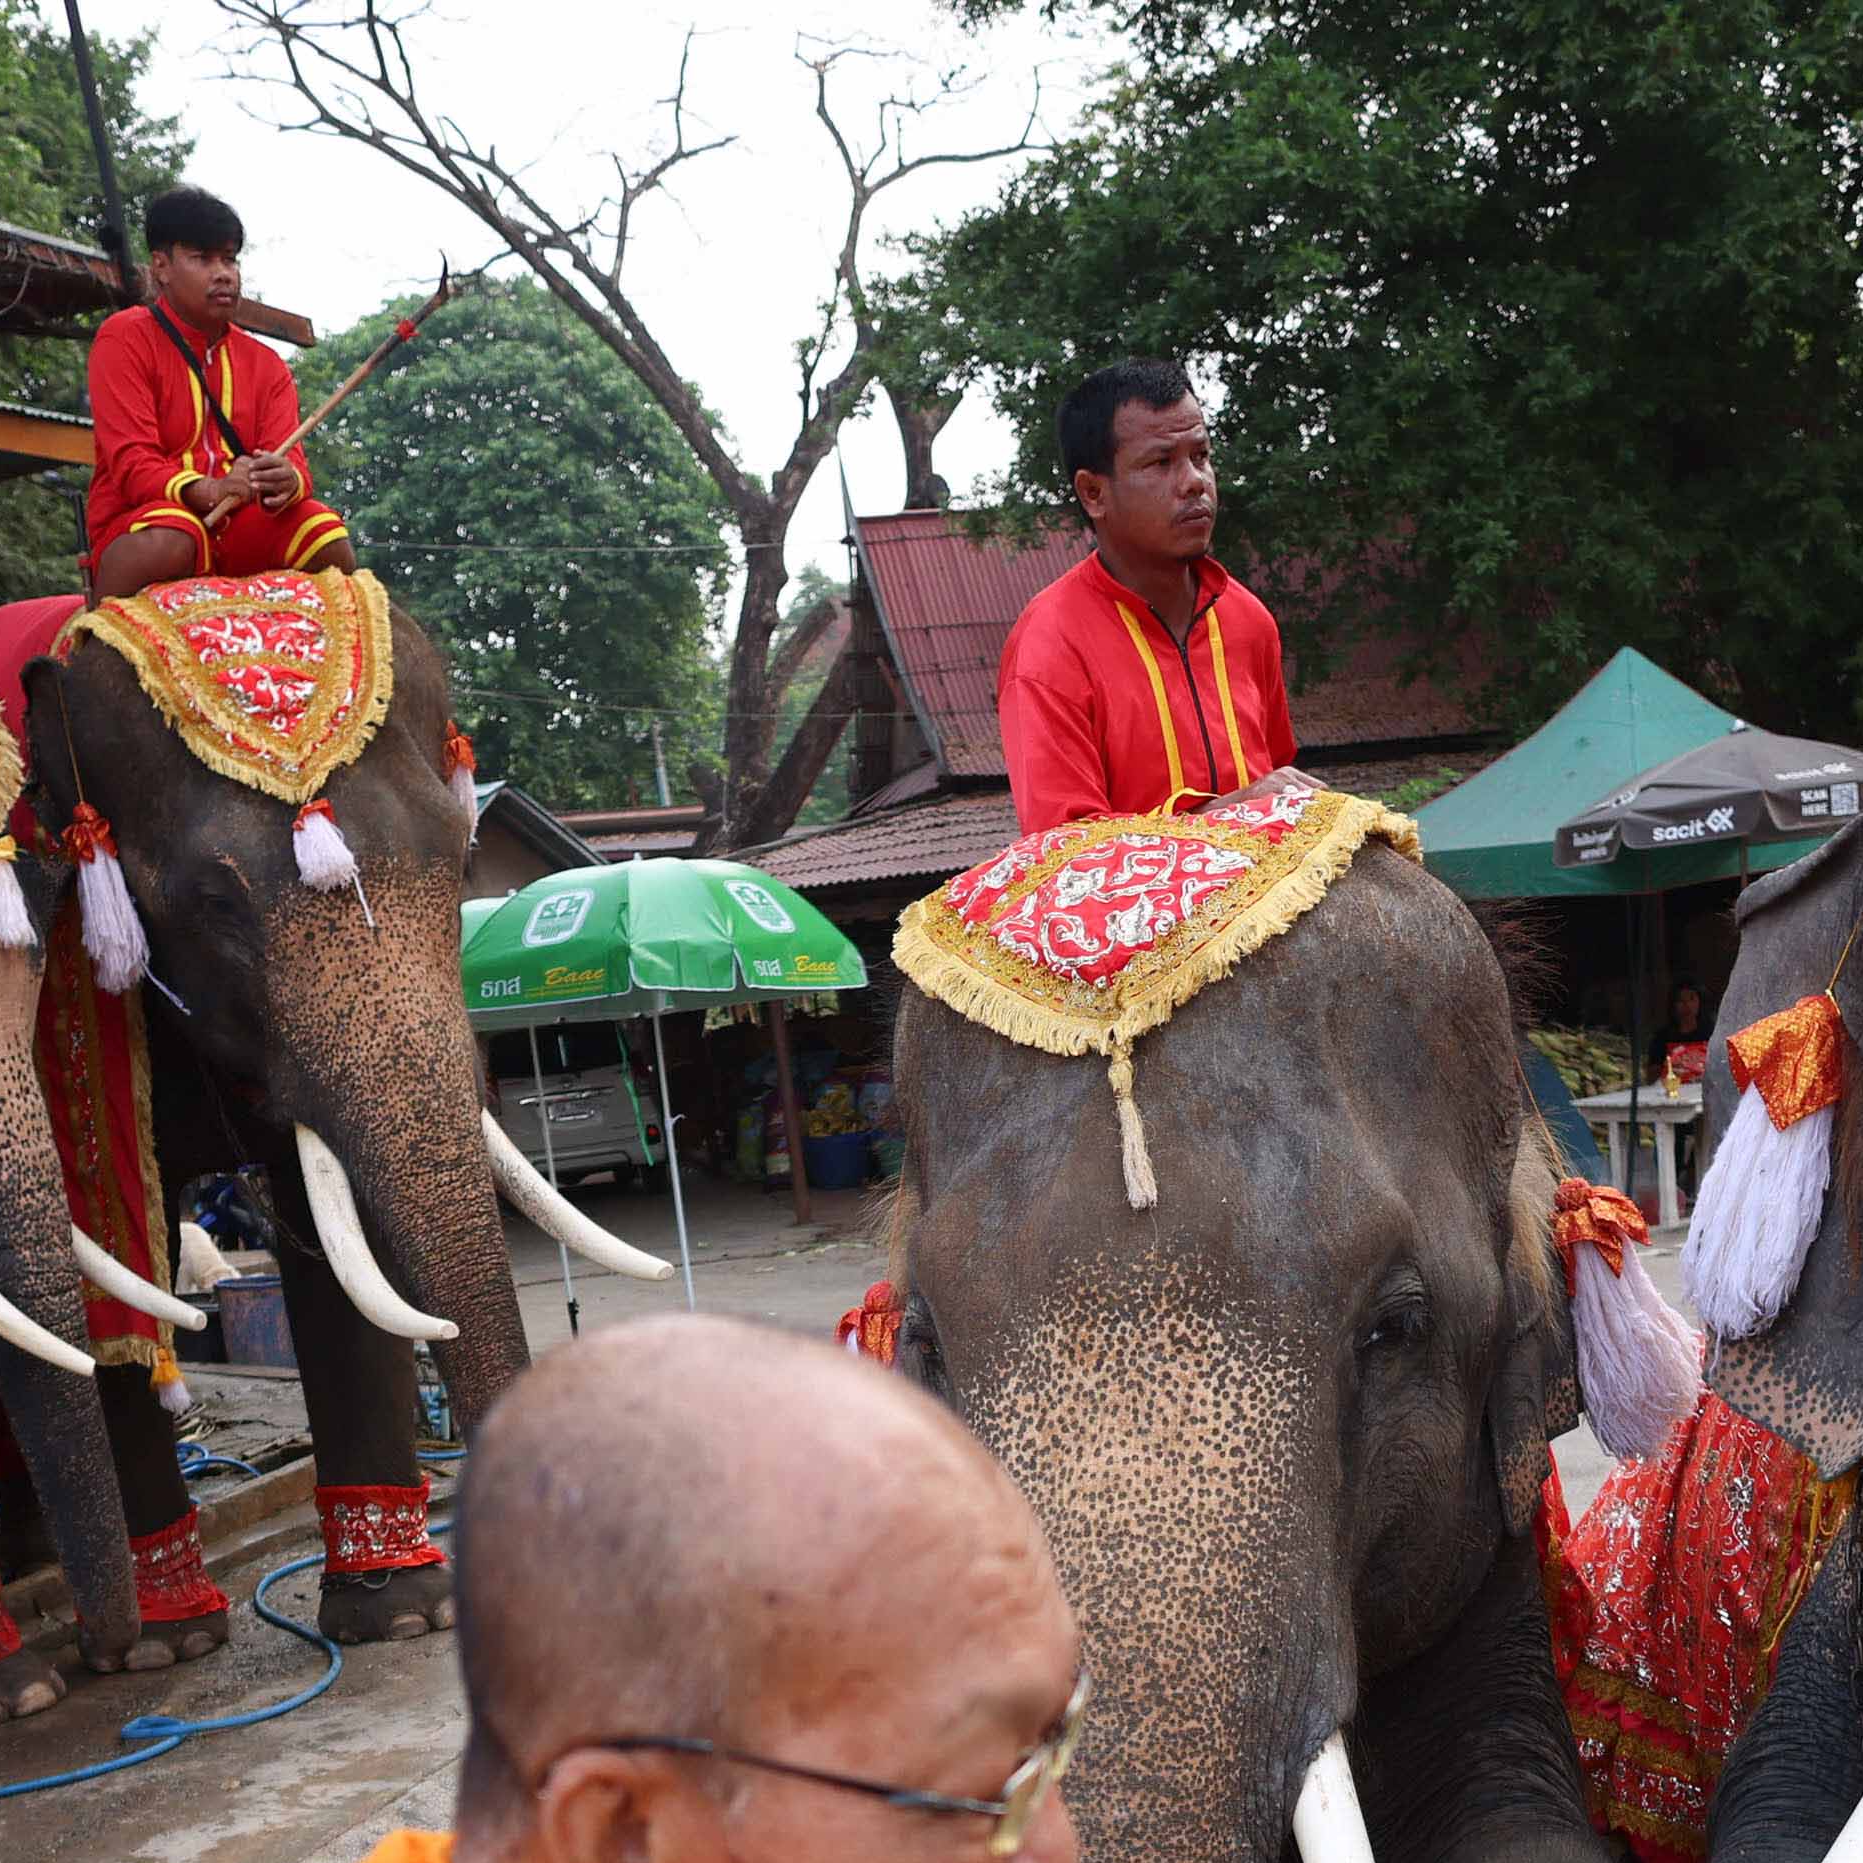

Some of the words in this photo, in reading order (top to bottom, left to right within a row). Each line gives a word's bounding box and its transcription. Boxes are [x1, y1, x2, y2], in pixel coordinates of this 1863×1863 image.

[1652, 819, 1706, 842] sacit
[545, 966, 605, 986] Baac
[752, 958, 783, 977] ธกส
[480, 975, 522, 998] ธกส
